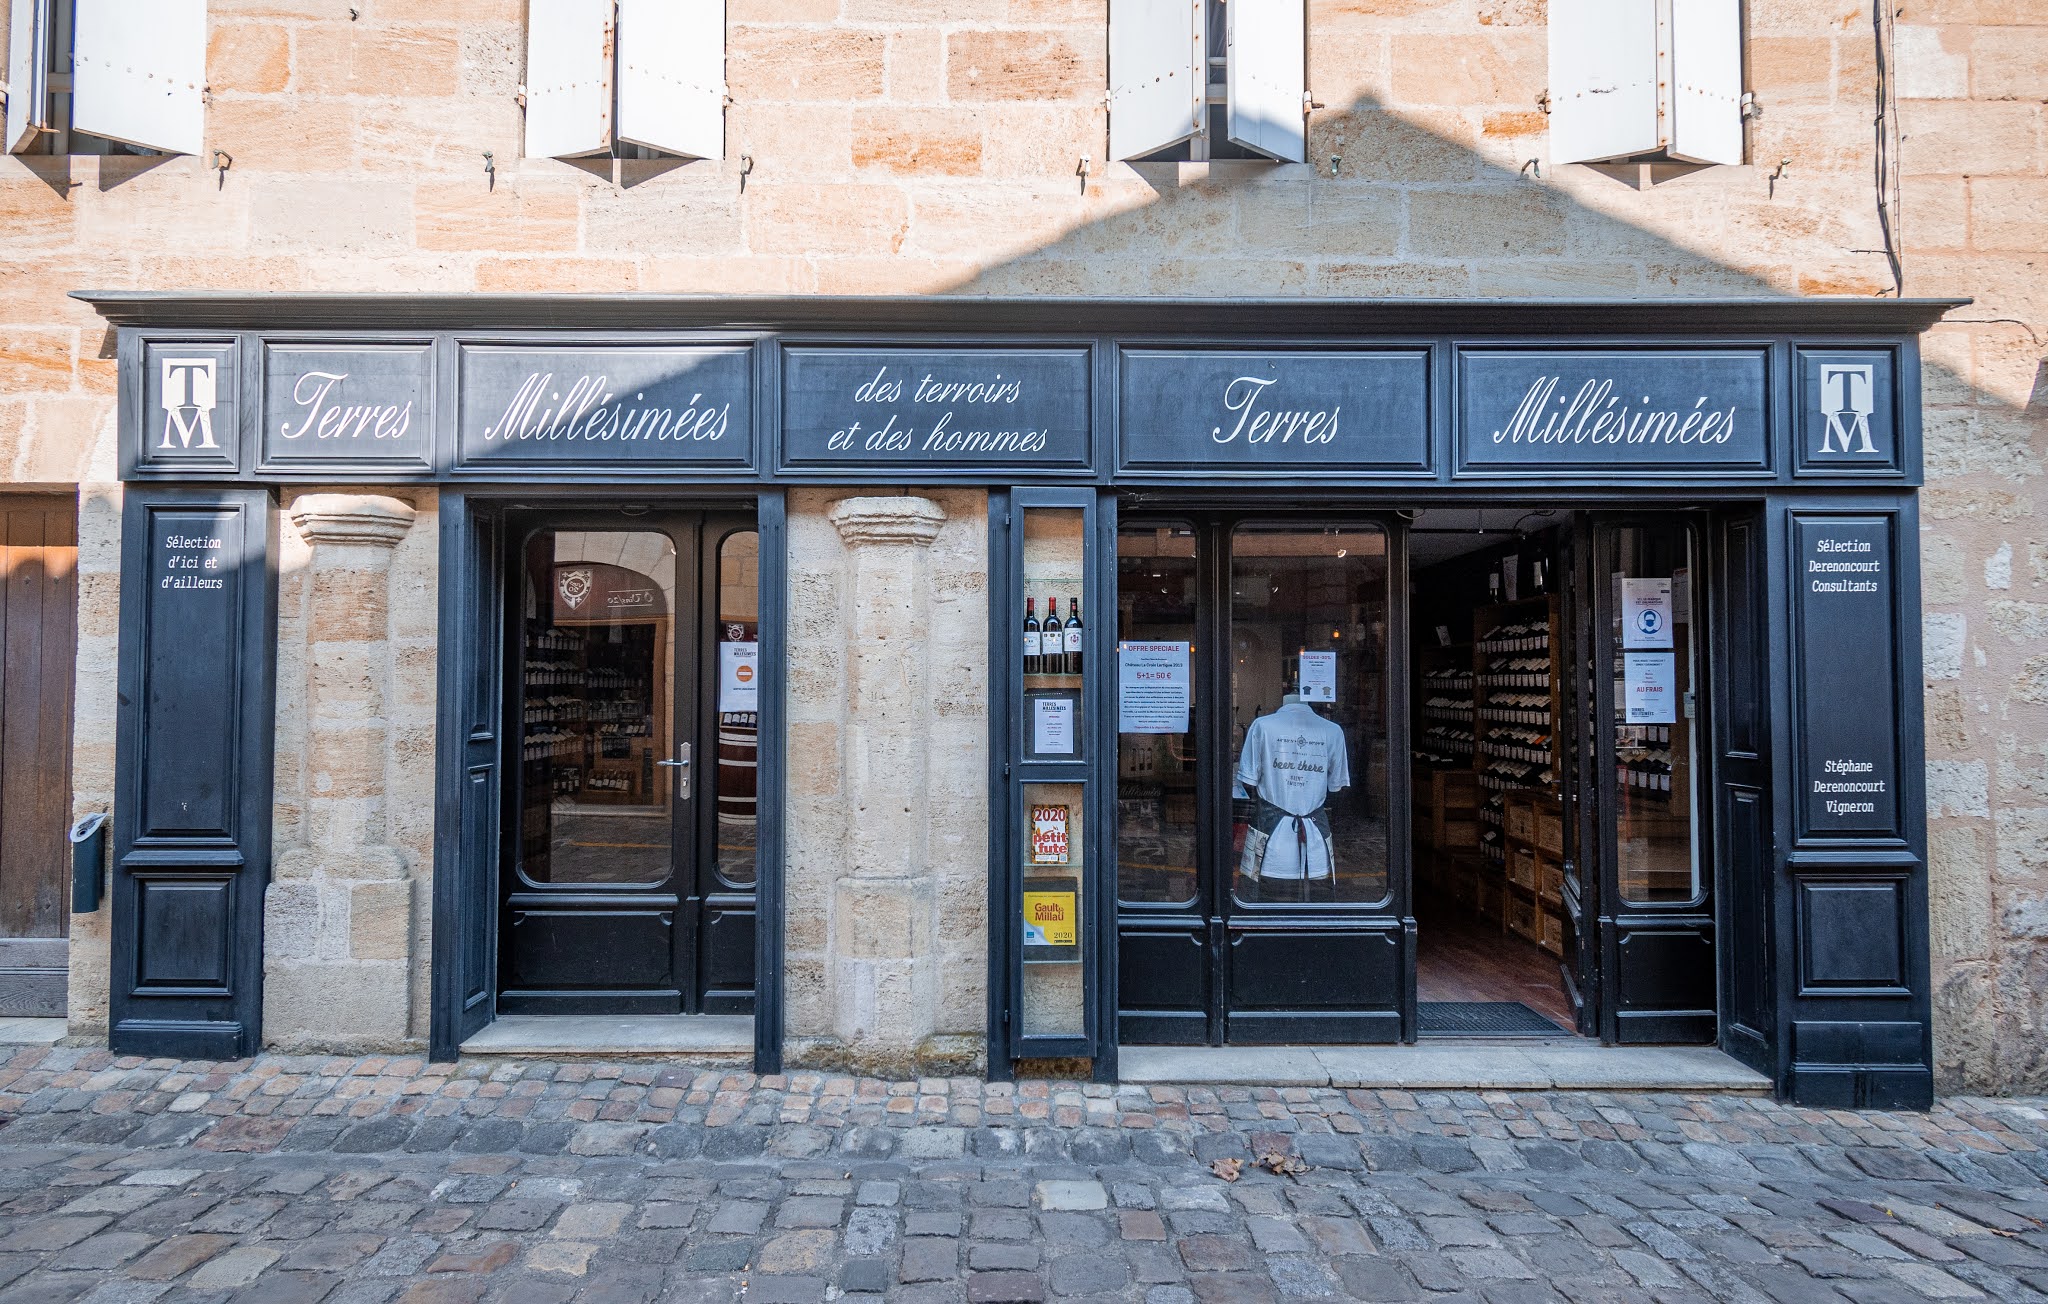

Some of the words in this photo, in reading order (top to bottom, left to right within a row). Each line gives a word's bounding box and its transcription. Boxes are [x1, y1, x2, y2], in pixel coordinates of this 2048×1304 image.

[855, 366, 903, 403] des
[914, 373, 1021, 403] terroirs
[281, 371, 412, 439] Terres
[484, 371, 730, 441] Millésimées
[1212, 376, 1340, 444] Terres
[1493, 376, 1736, 444] Millésimées
[827, 421, 861, 451] et
[865, 414, 913, 451] des
[922, 411, 1048, 452] hommes
[165, 535, 222, 549] Sélection
[1816, 538, 1871, 553] Sélection
[168, 556, 199, 569] d'ici
[204, 556, 218, 569] et
[1808, 560, 1881, 573] Derenoncourt
[161, 575, 223, 589] d'ailleurs
[1811, 579, 1878, 593] Consultants
[1272, 757, 1296, 770] been
[1297, 760, 1325, 773] there
[1824, 759, 1873, 775] Stéphane
[1813, 780, 1886, 793] Derenoncourt
[1034, 808, 1066, 822] 2020
[1825, 800, 1874, 816] Vigneron
[1033, 832, 1068, 845] petit
[1034, 903, 1059, 912] Gault
[1034, 912, 1065, 921] Millau
[1053, 931, 1073, 939] 2020
